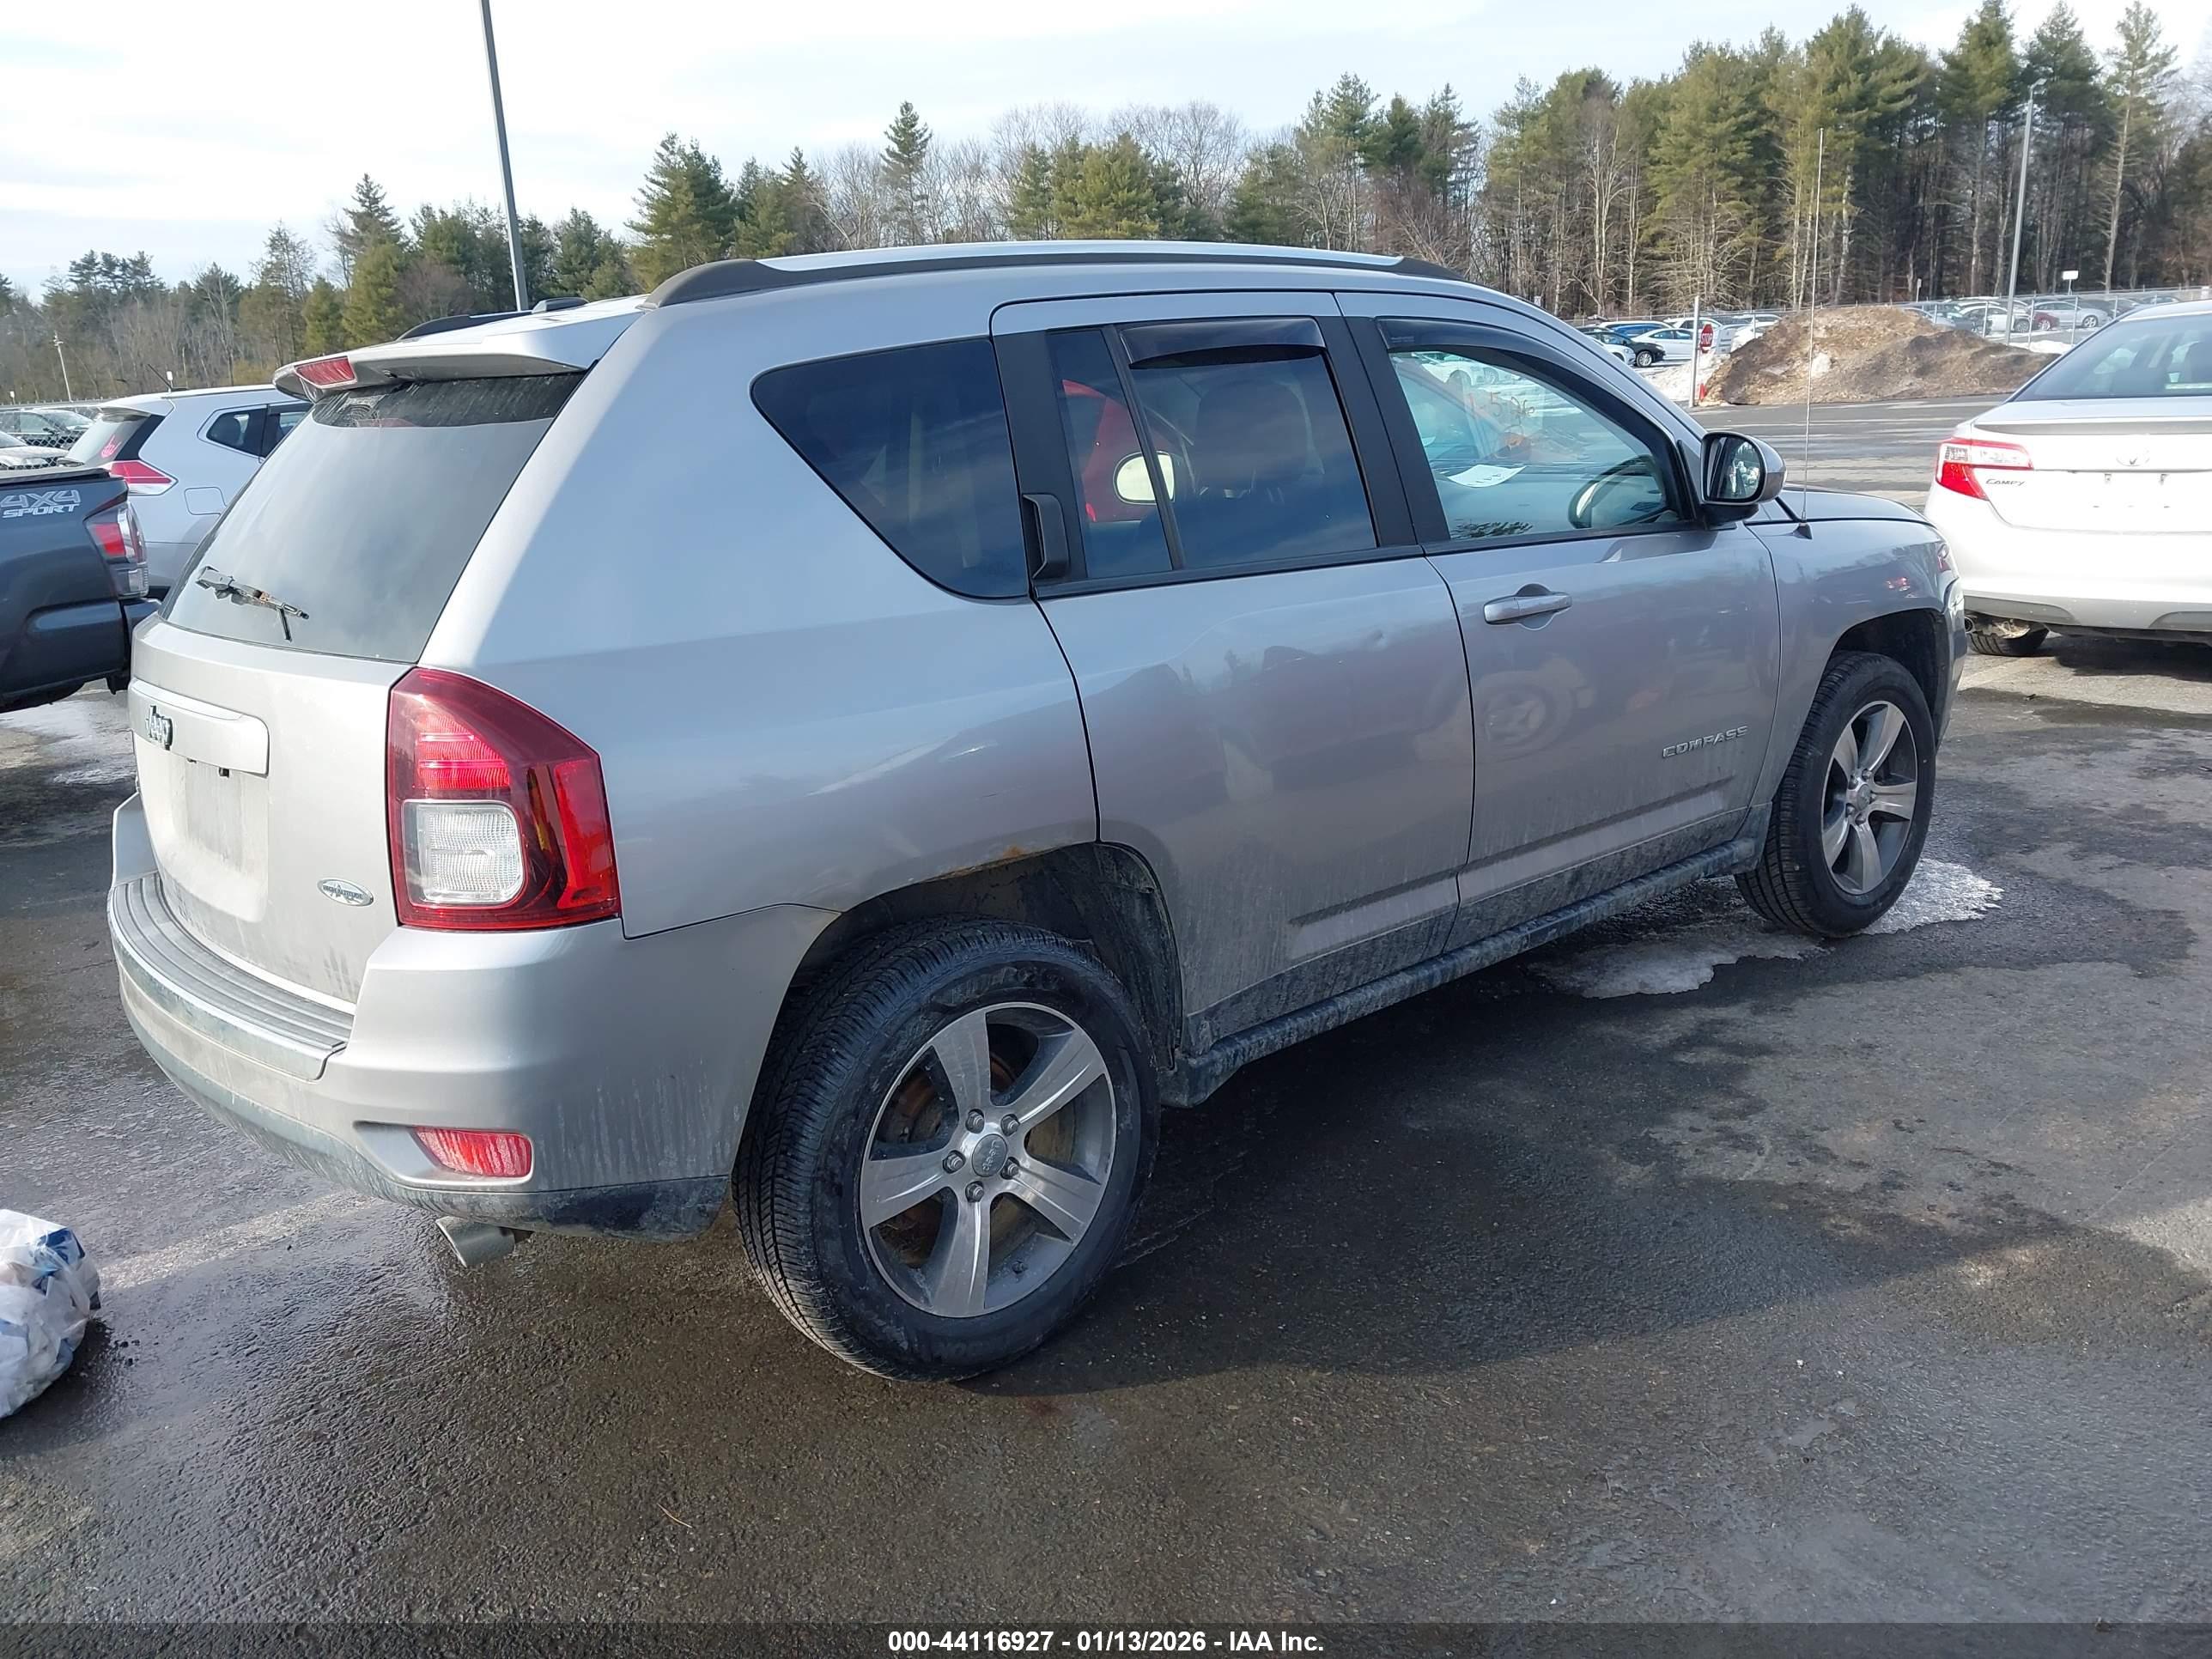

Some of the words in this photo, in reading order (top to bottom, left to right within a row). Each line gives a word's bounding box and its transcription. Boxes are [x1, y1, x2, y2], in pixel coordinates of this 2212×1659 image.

[1701, 333, 1713, 344] STOP
[2, 503, 81, 519] SPORT
[145, 704, 173, 751] Jeep
[1662, 725, 1749, 758] COMPASS
[981, 1139, 1000, 1171] Jeep
